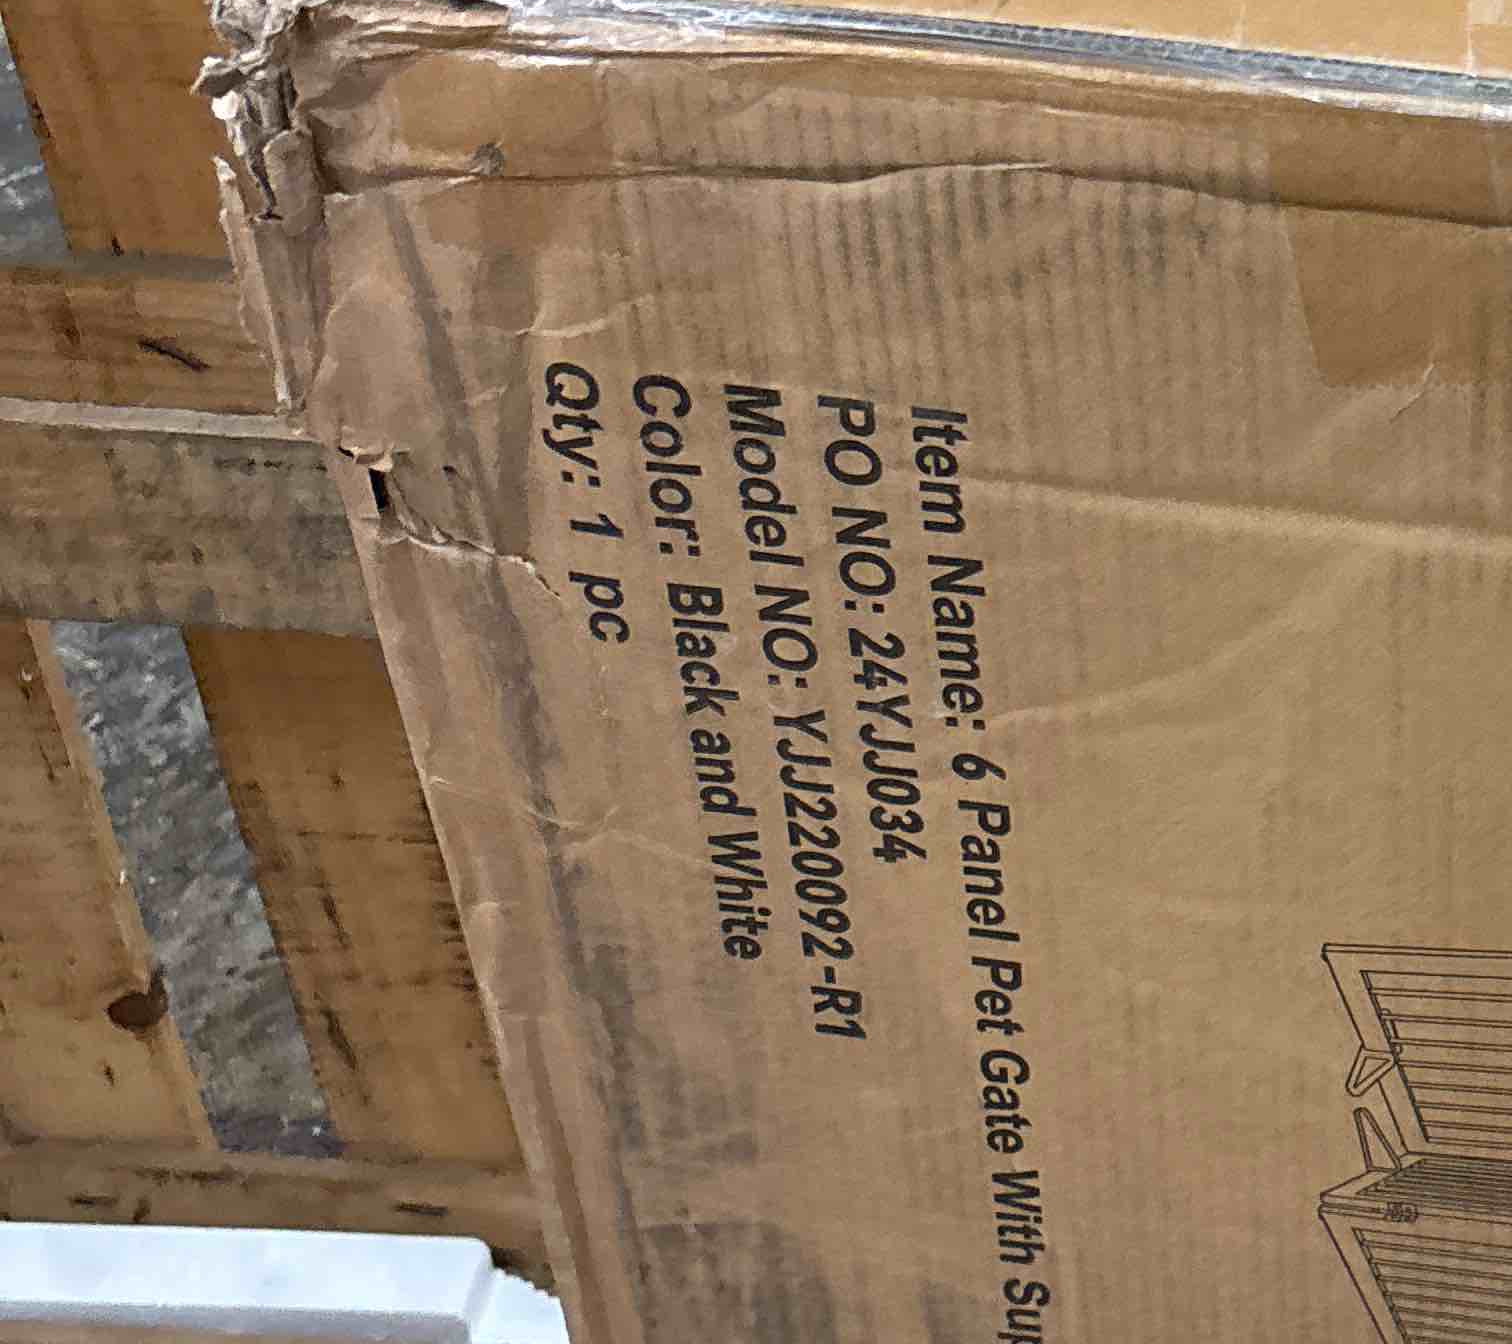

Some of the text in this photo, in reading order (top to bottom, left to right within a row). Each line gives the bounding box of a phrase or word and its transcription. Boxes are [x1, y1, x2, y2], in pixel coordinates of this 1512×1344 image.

[543, 363, 629, 642] Qty: 1 pc
[912, 407, 967, 533] Item
[633, 375, 771, 960] Color: Black and White
[818, 396, 927, 863] PO NO: 24YJJ034
[928, 555, 985, 729] Name:
[724, 384, 868, 1040] Model NO: YJJ220092-R1
[952, 754, 1005, 779] 6
[959, 800, 1019, 941] Panel
[972, 957, 1024, 1035] Pet
[981, 1050, 1030, 1153] Gate
[992, 1171, 1045, 1264] With
